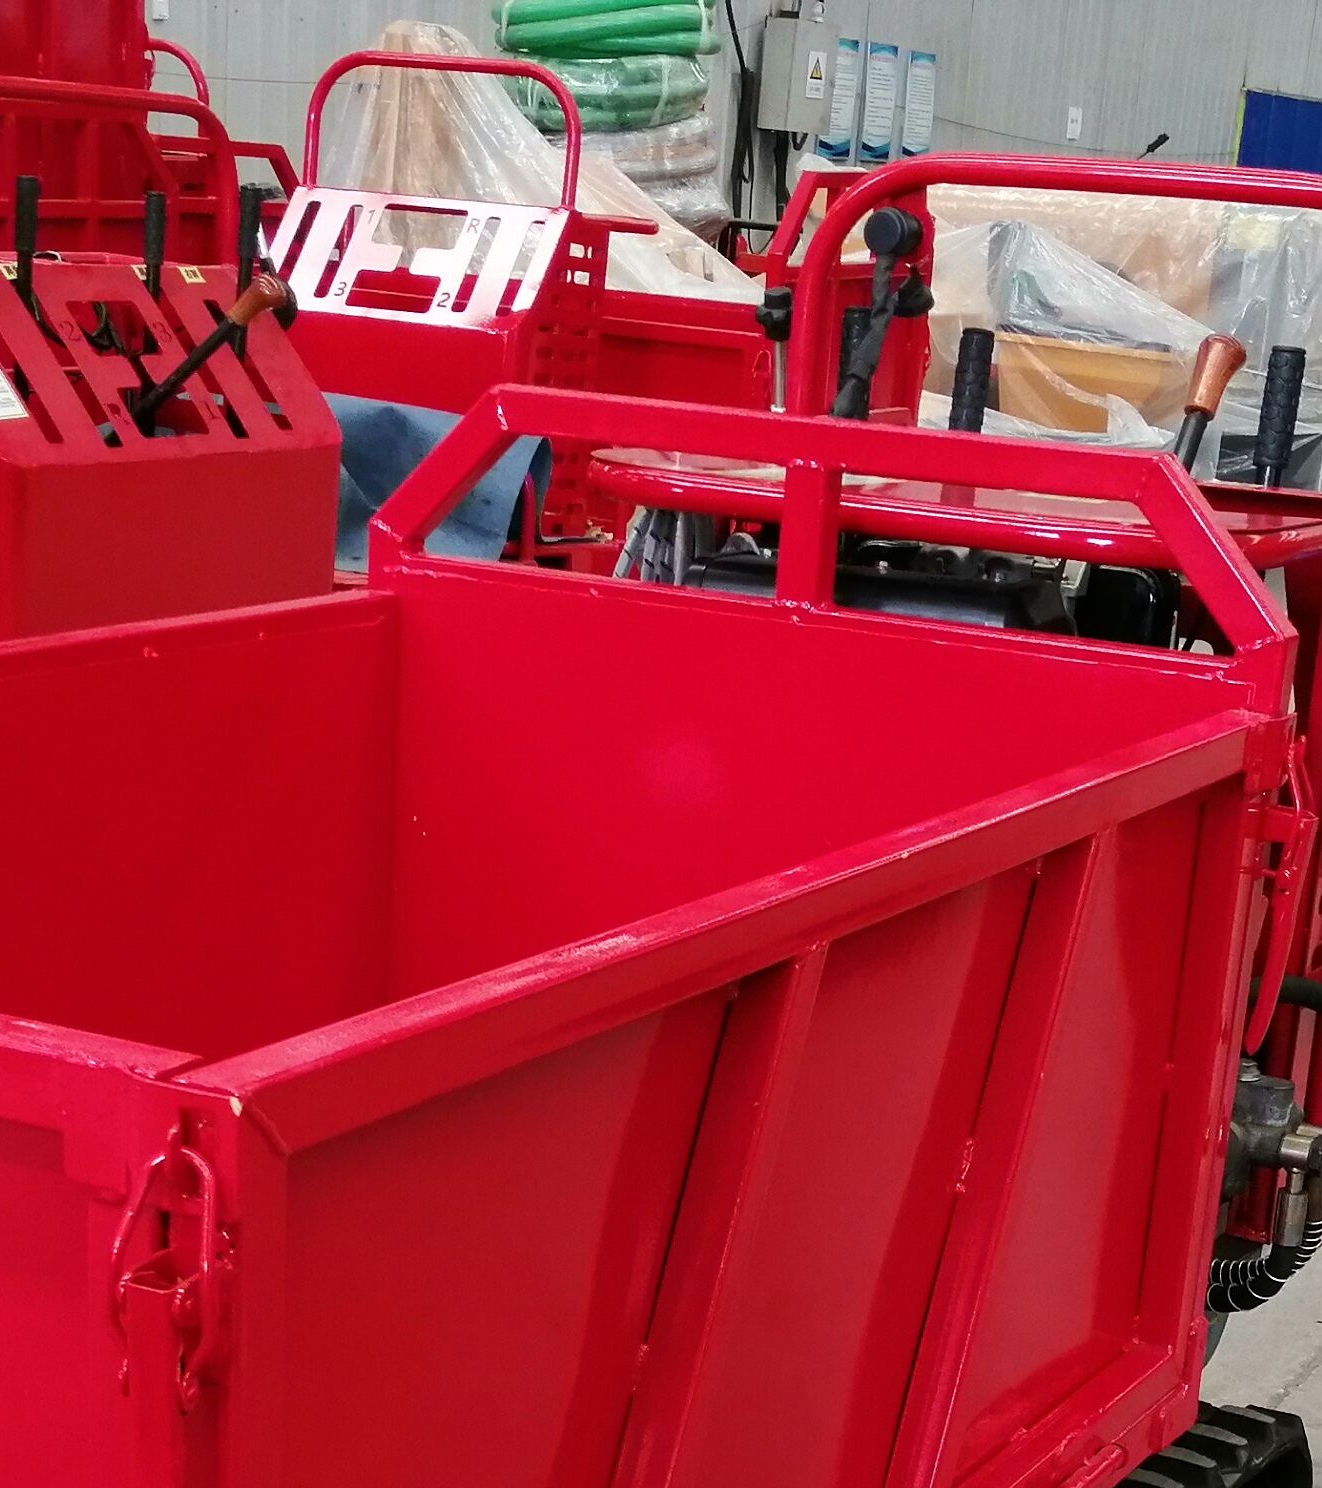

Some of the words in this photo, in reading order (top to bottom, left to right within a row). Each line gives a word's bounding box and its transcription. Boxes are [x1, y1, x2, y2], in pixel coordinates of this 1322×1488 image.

[367, 209, 376, 225] 1
[466, 218, 481, 234] R
[333, 281, 348, 297] 3
[436, 292, 451, 308] 2
[59, 320, 81, 342] 2
[152, 321, 173, 343] 3
[203, 400, 222, 420] 1
